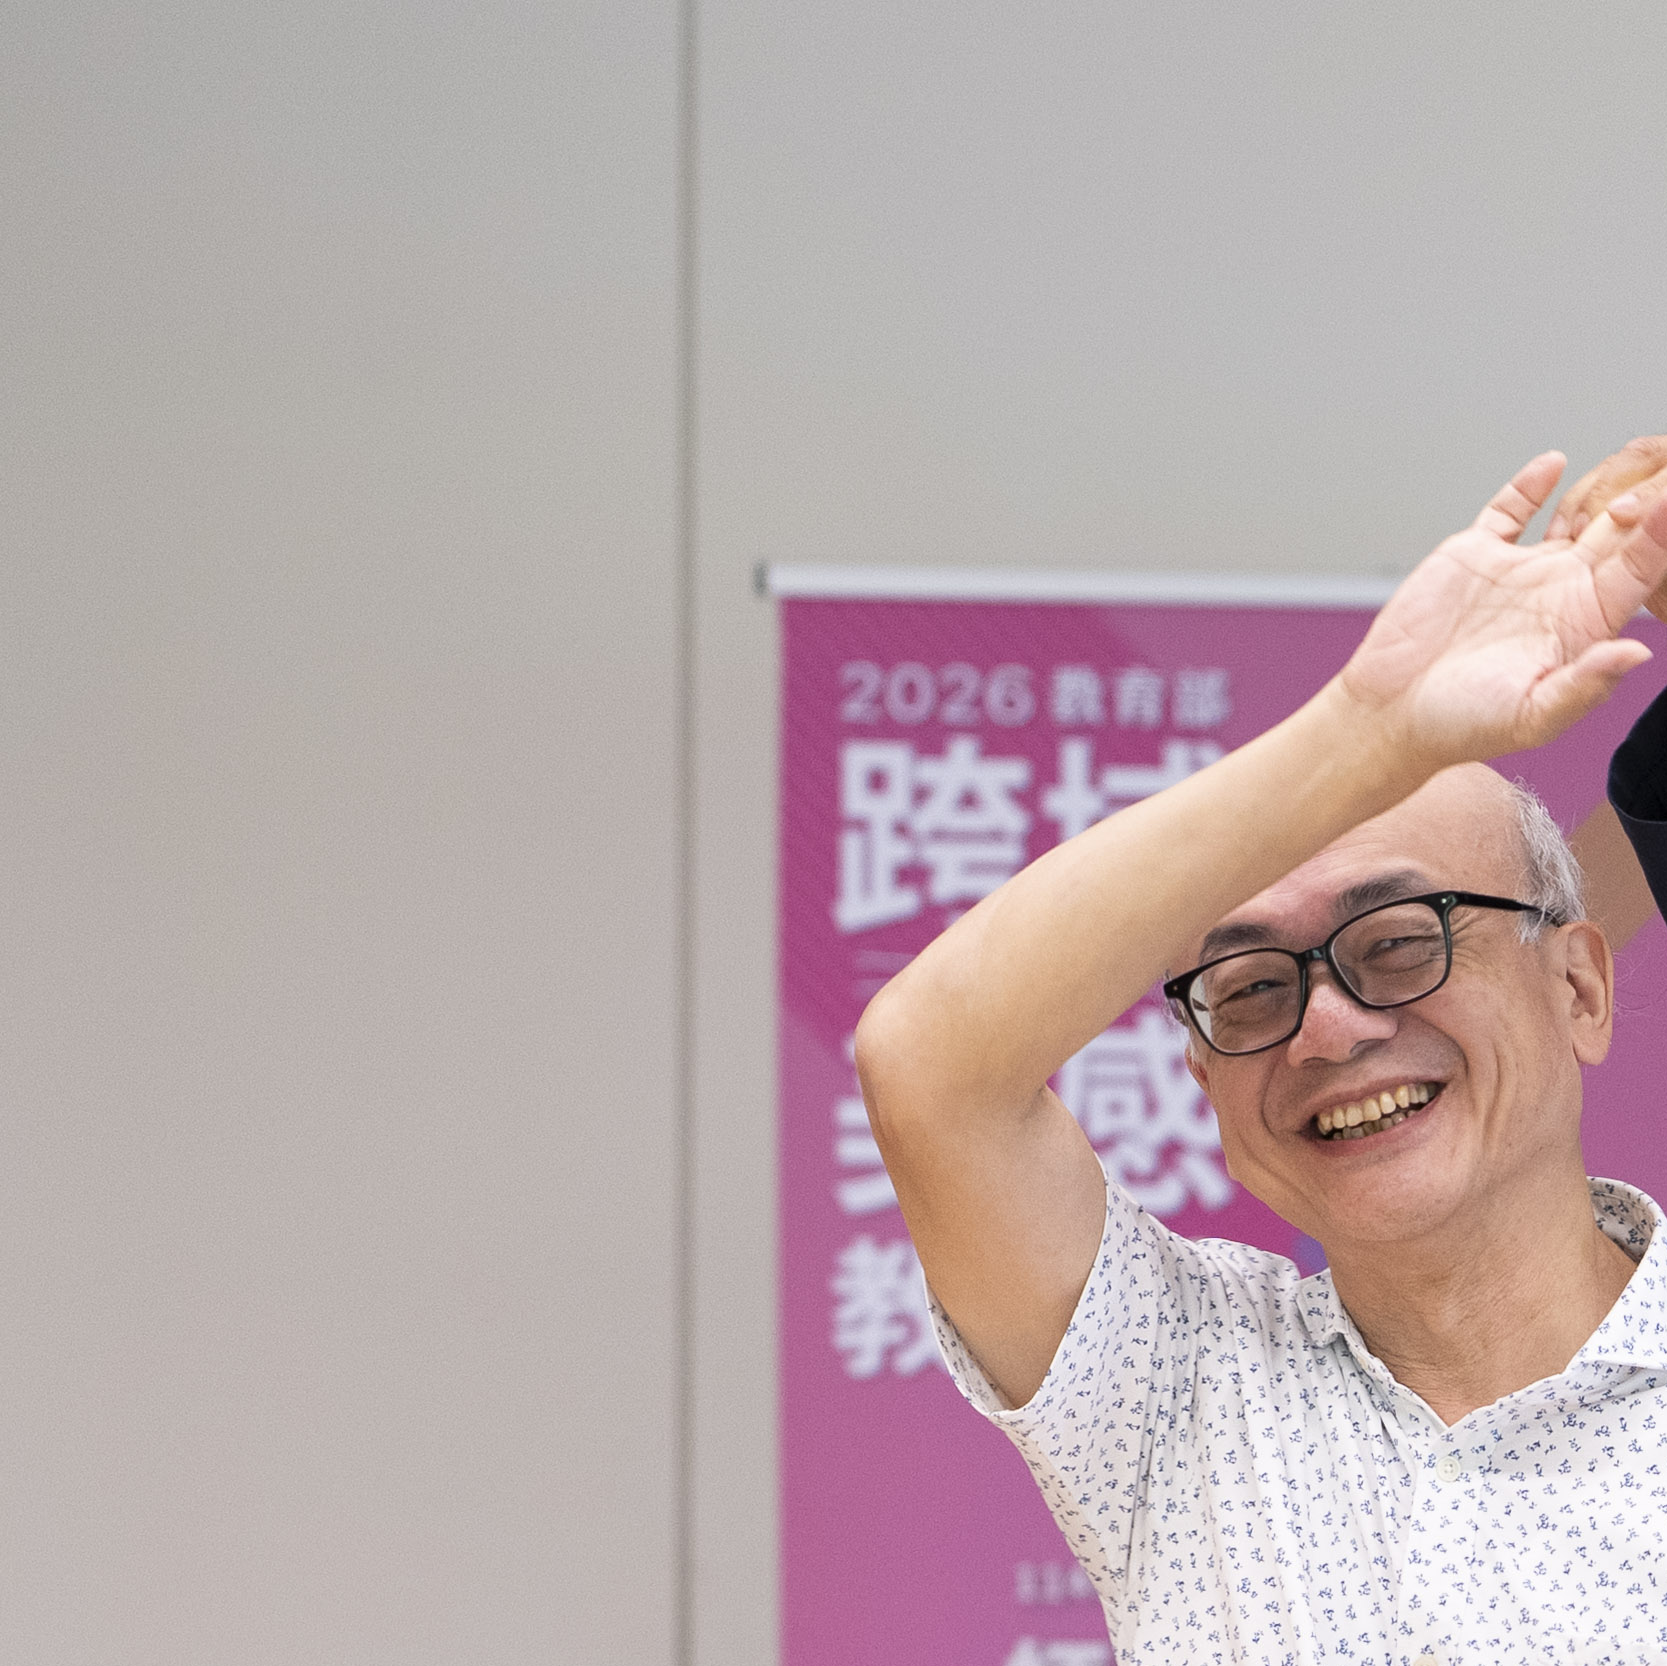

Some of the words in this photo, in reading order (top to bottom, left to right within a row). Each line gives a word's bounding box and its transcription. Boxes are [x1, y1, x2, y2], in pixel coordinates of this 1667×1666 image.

[841, 661, 1036, 727] 2026
[1050, 666, 1237, 728] 教育部
